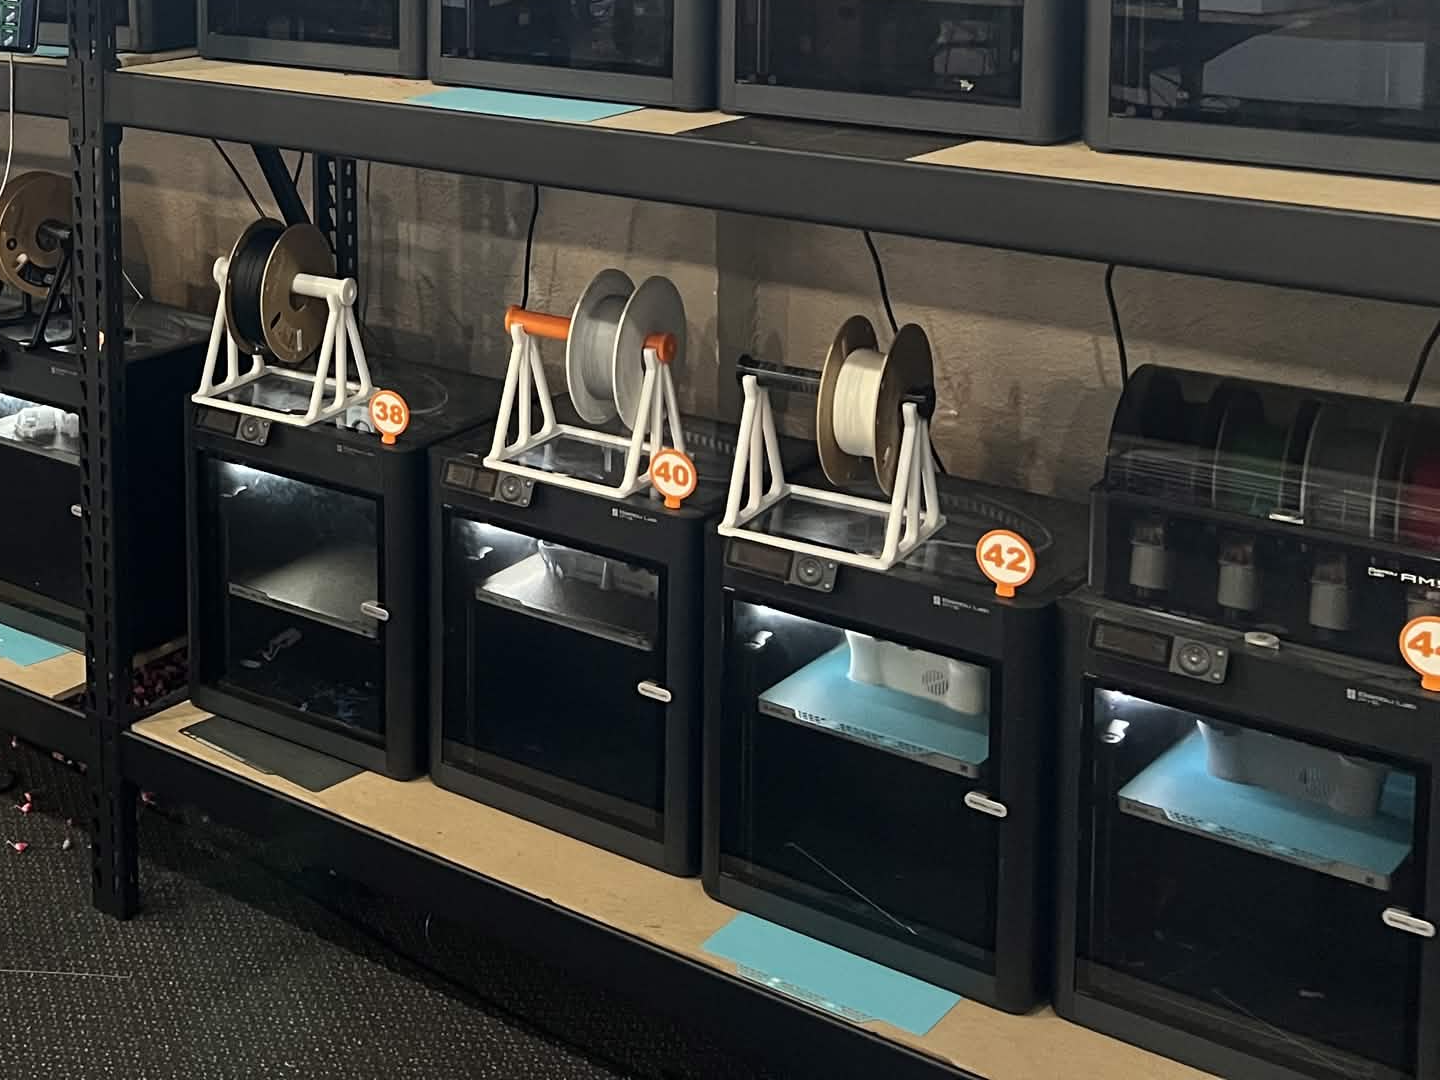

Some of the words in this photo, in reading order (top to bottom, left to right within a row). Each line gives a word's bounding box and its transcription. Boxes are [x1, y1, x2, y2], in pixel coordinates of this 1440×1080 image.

[375, 400, 404, 425] 38
[655, 461, 689, 488] 40
[983, 543, 1028, 574] 42
[1407, 631, 1440, 658] 4
